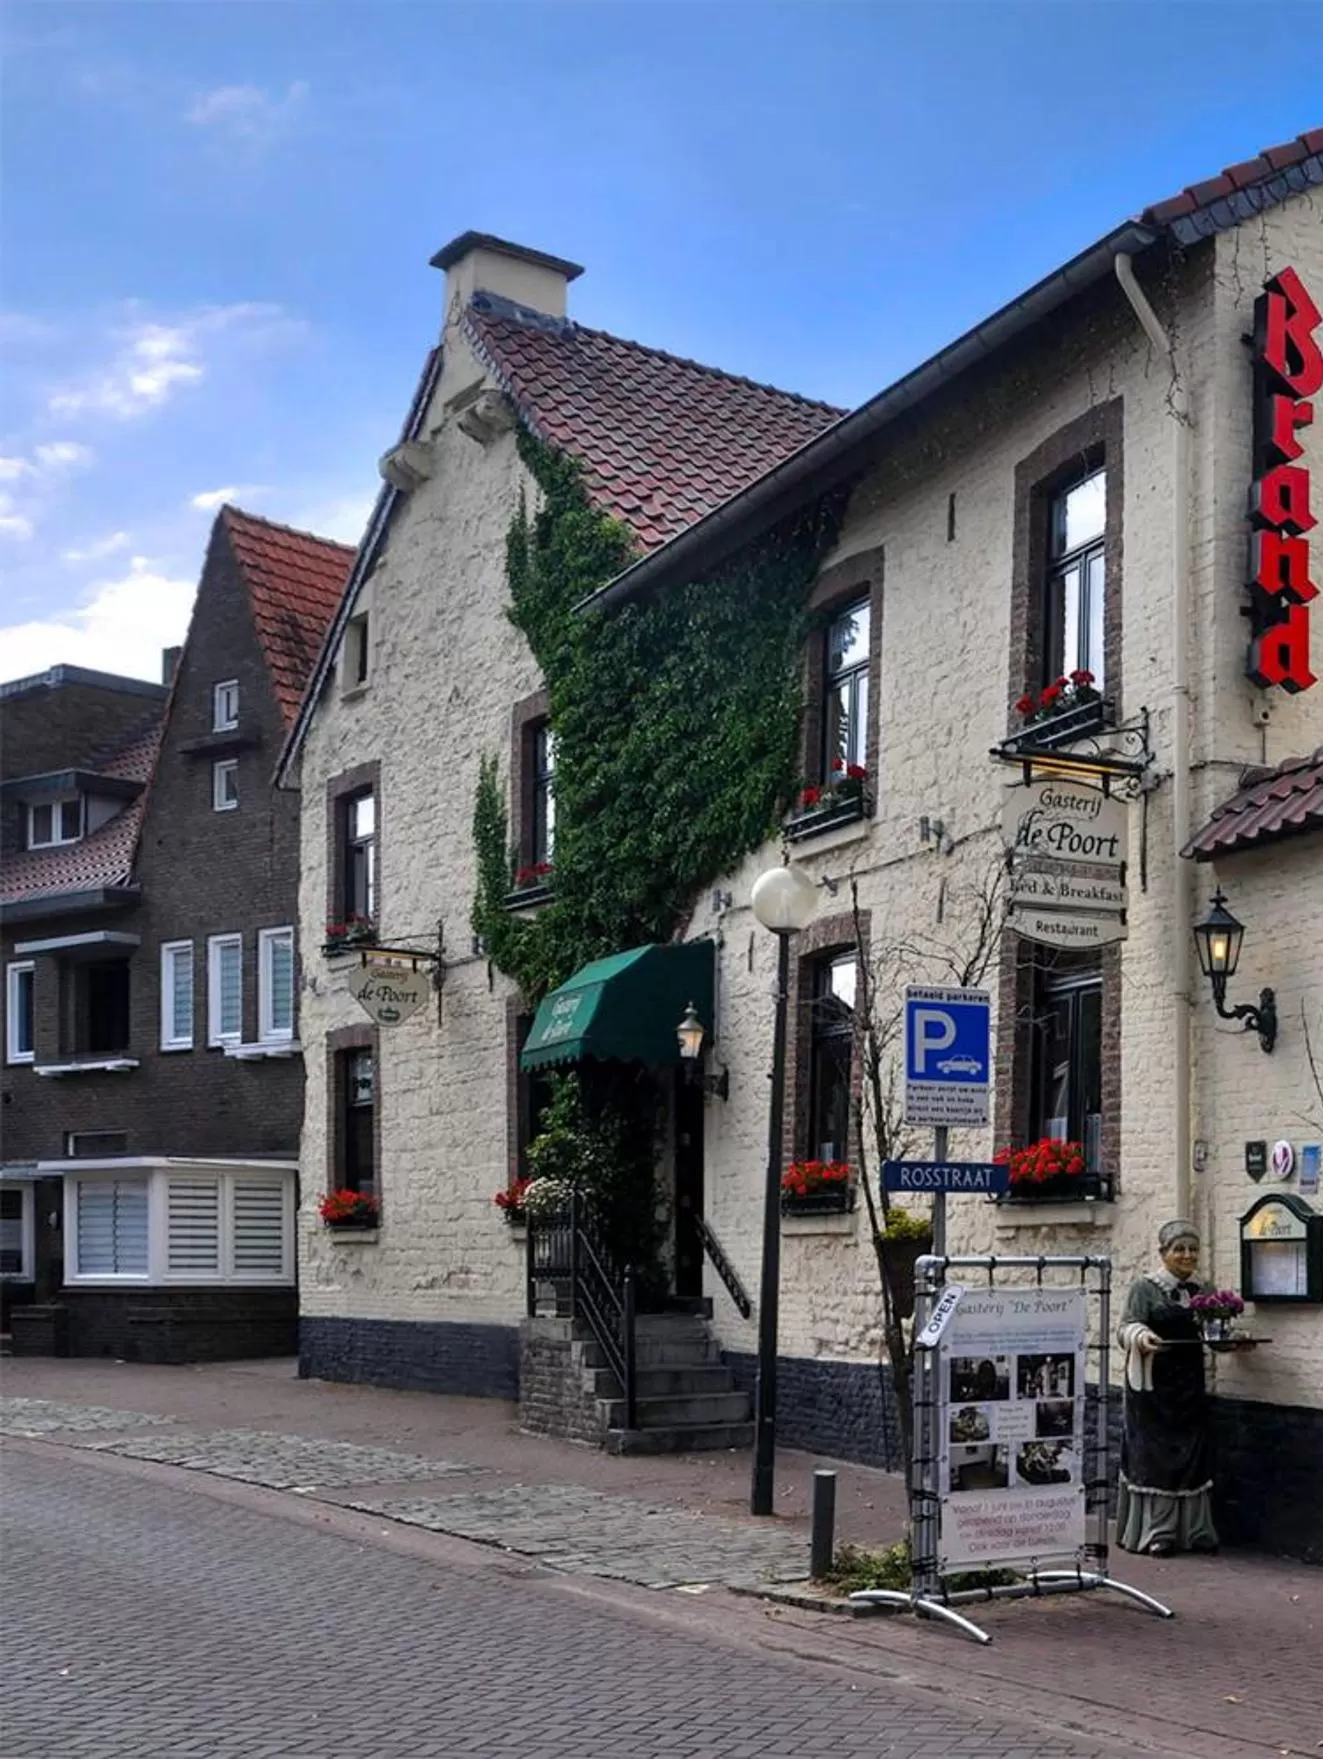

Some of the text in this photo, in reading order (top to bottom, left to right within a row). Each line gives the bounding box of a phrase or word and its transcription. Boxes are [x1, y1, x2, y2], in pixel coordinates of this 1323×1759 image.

[1040, 788, 1102, 819] Gasterij
[1016, 810, 1119, 857] de Poort
[1060, 883, 1125, 902] Breakfast
[1036, 920, 1099, 938] Restaurant
[357, 980, 418, 1003] de Poort
[914, 1009, 957, 1074] P
[900, 1166, 993, 1188] ROSSTRAAT
[928, 1293, 956, 1333] OPEN
